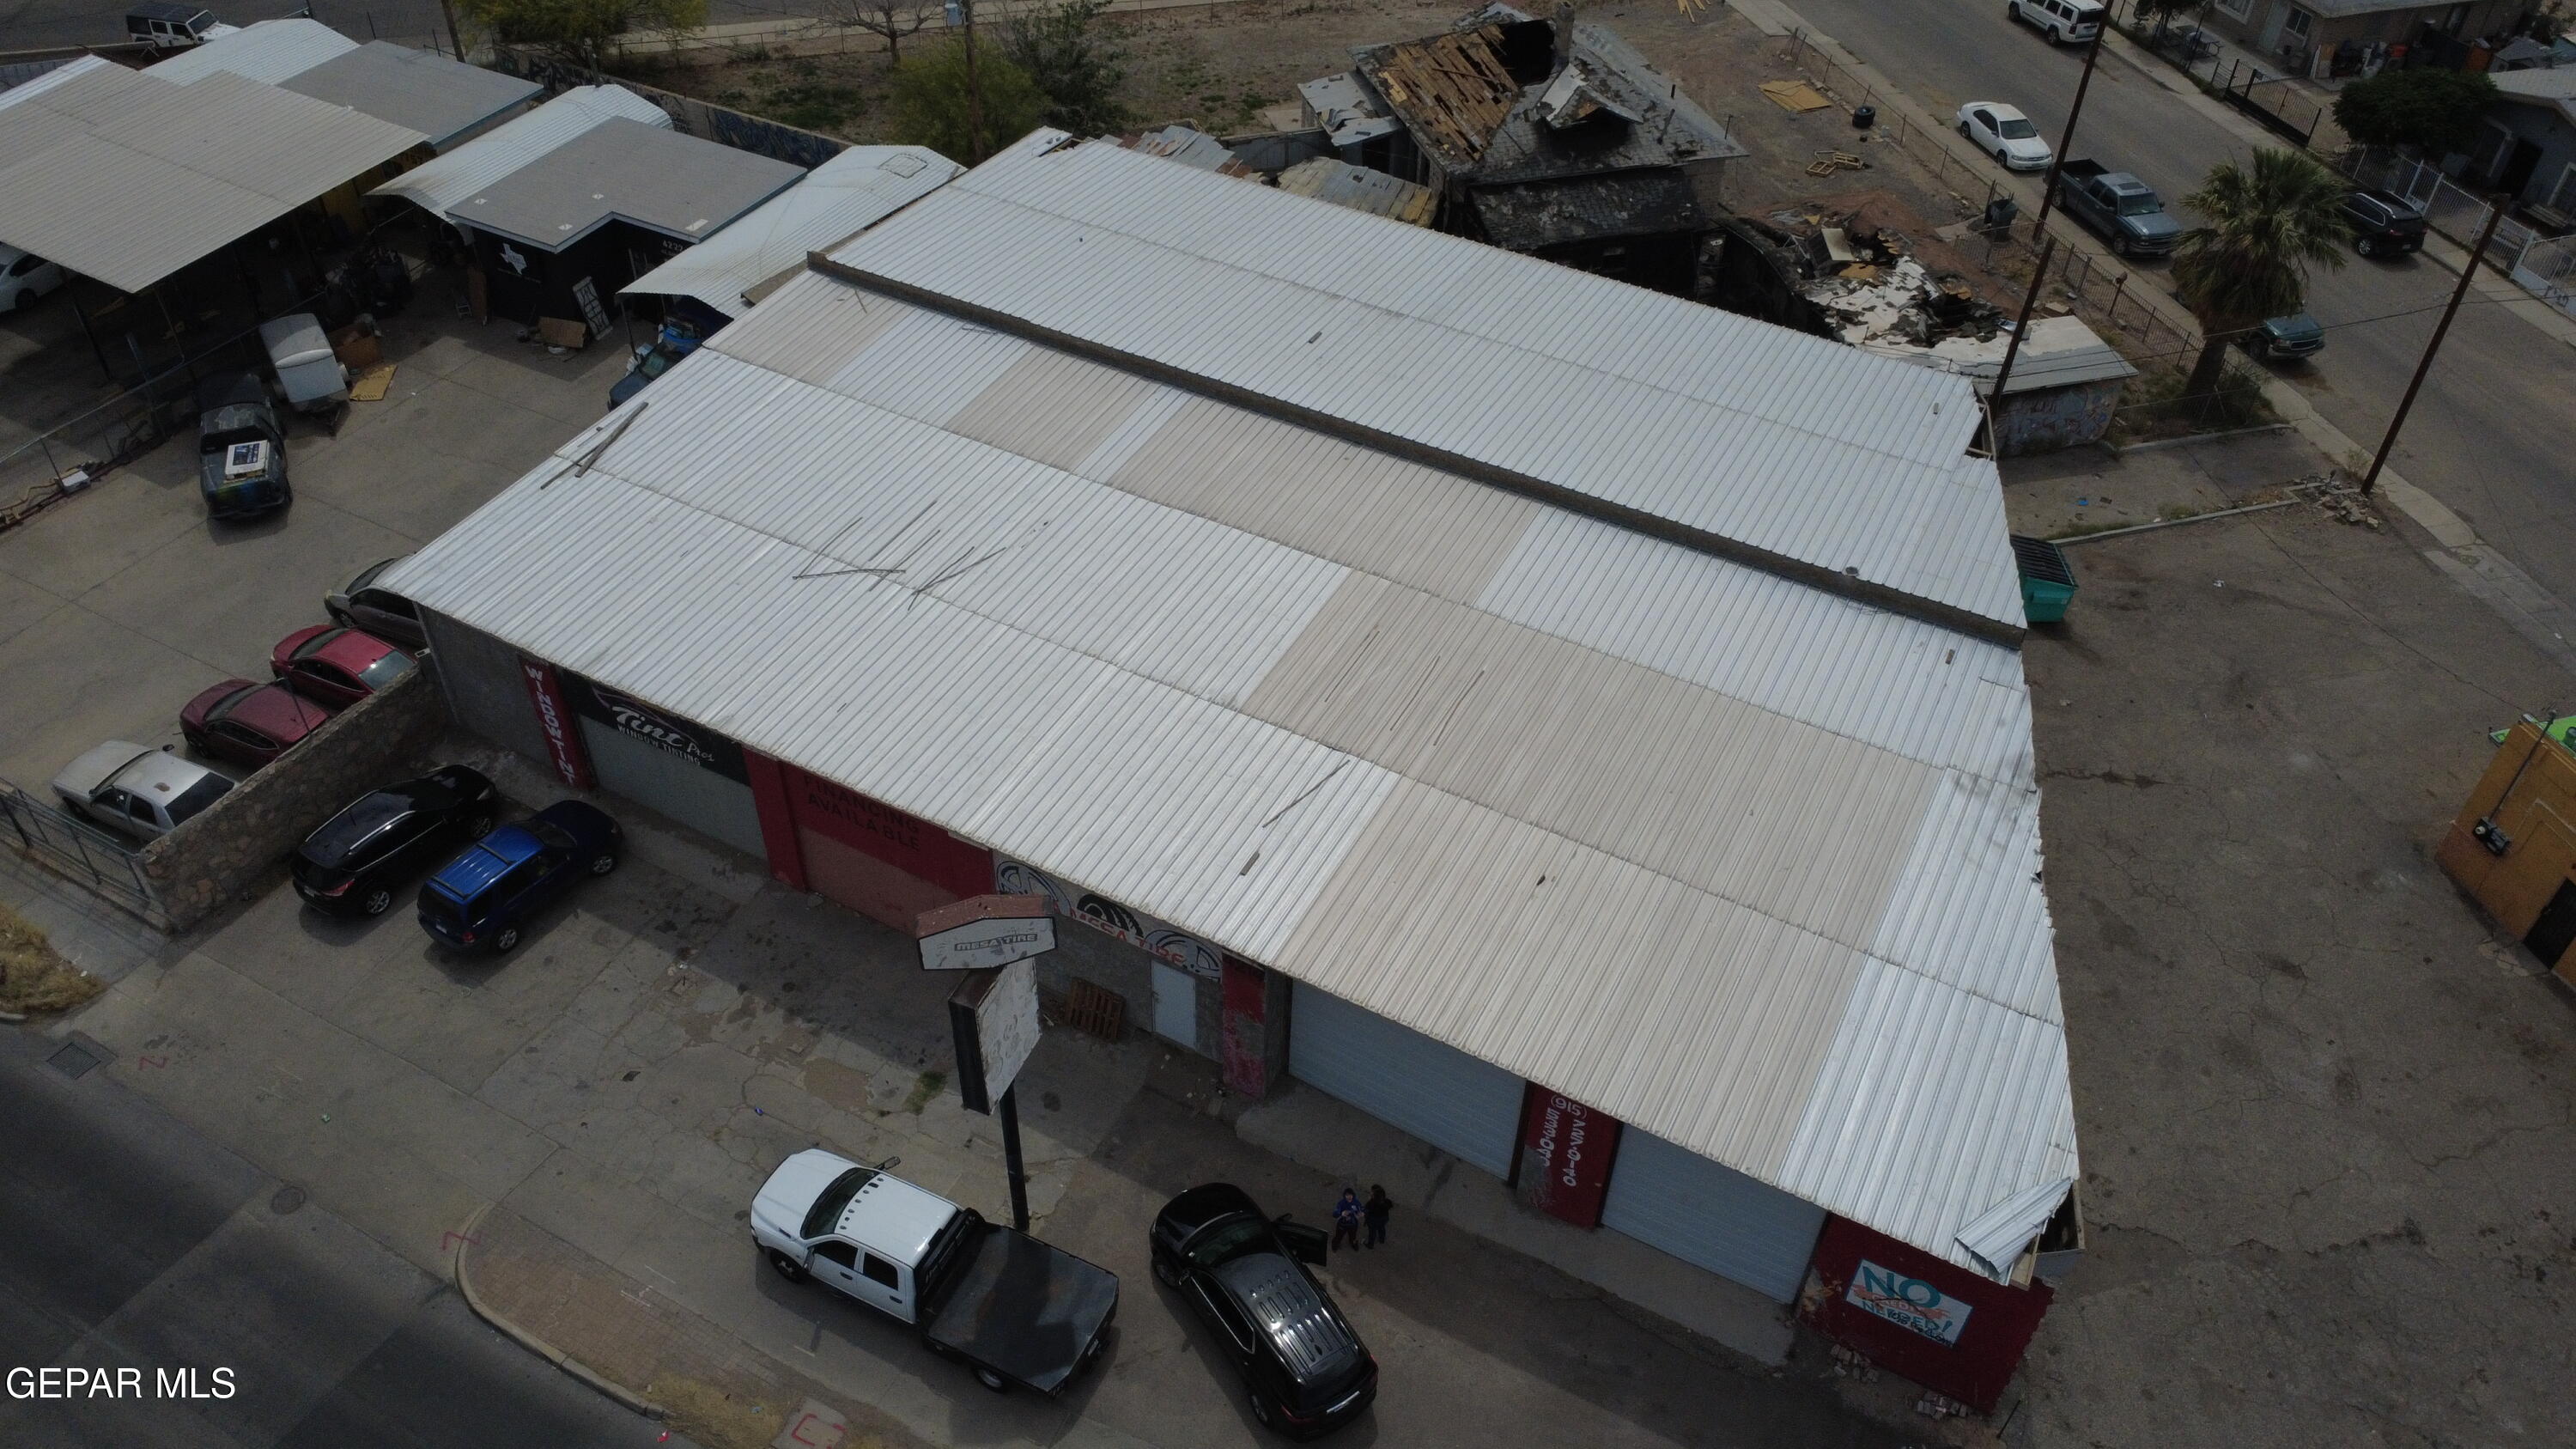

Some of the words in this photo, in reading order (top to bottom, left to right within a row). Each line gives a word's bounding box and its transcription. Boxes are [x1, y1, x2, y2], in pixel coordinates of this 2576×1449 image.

[804, 775, 920, 833] FINANCING
[809, 793, 921, 852] AVAILABLE
[1551, 1093, 1588, 1119] (915)
[1862, 1266, 1941, 1308] NO
